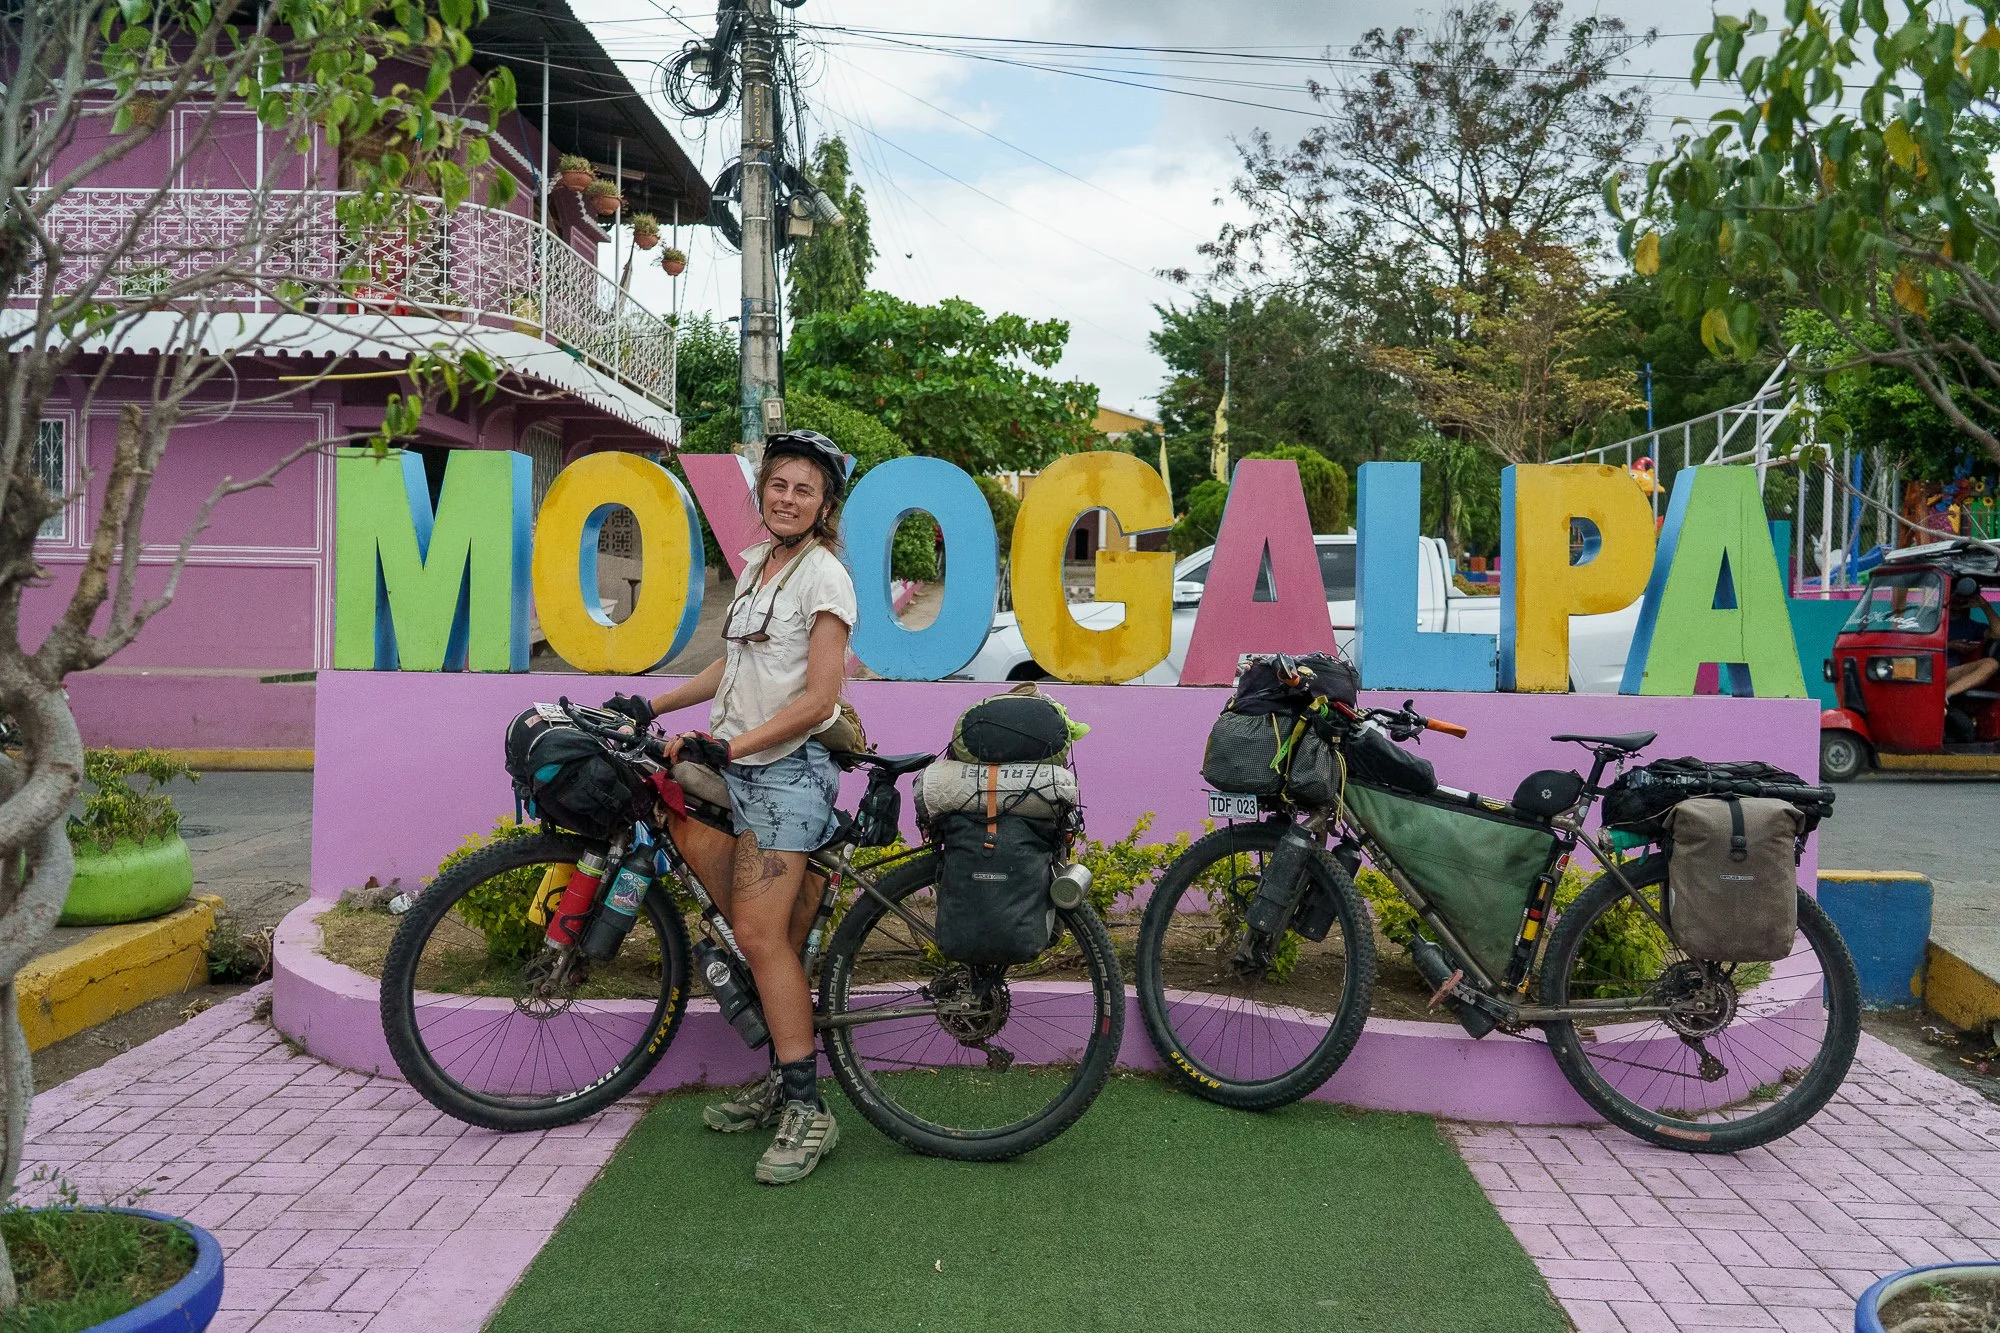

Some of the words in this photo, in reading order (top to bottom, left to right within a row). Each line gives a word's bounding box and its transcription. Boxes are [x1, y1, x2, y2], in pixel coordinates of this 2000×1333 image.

[968, 767, 1050, 779] PERLTE
[1210, 796, 1232, 813] TDF
[1236, 799, 1256, 815] 023
[828, 954, 844, 1014] RACIN
[649, 987, 680, 1055] MAXXIS
[1170, 1051, 1221, 1089] MAXXIS
